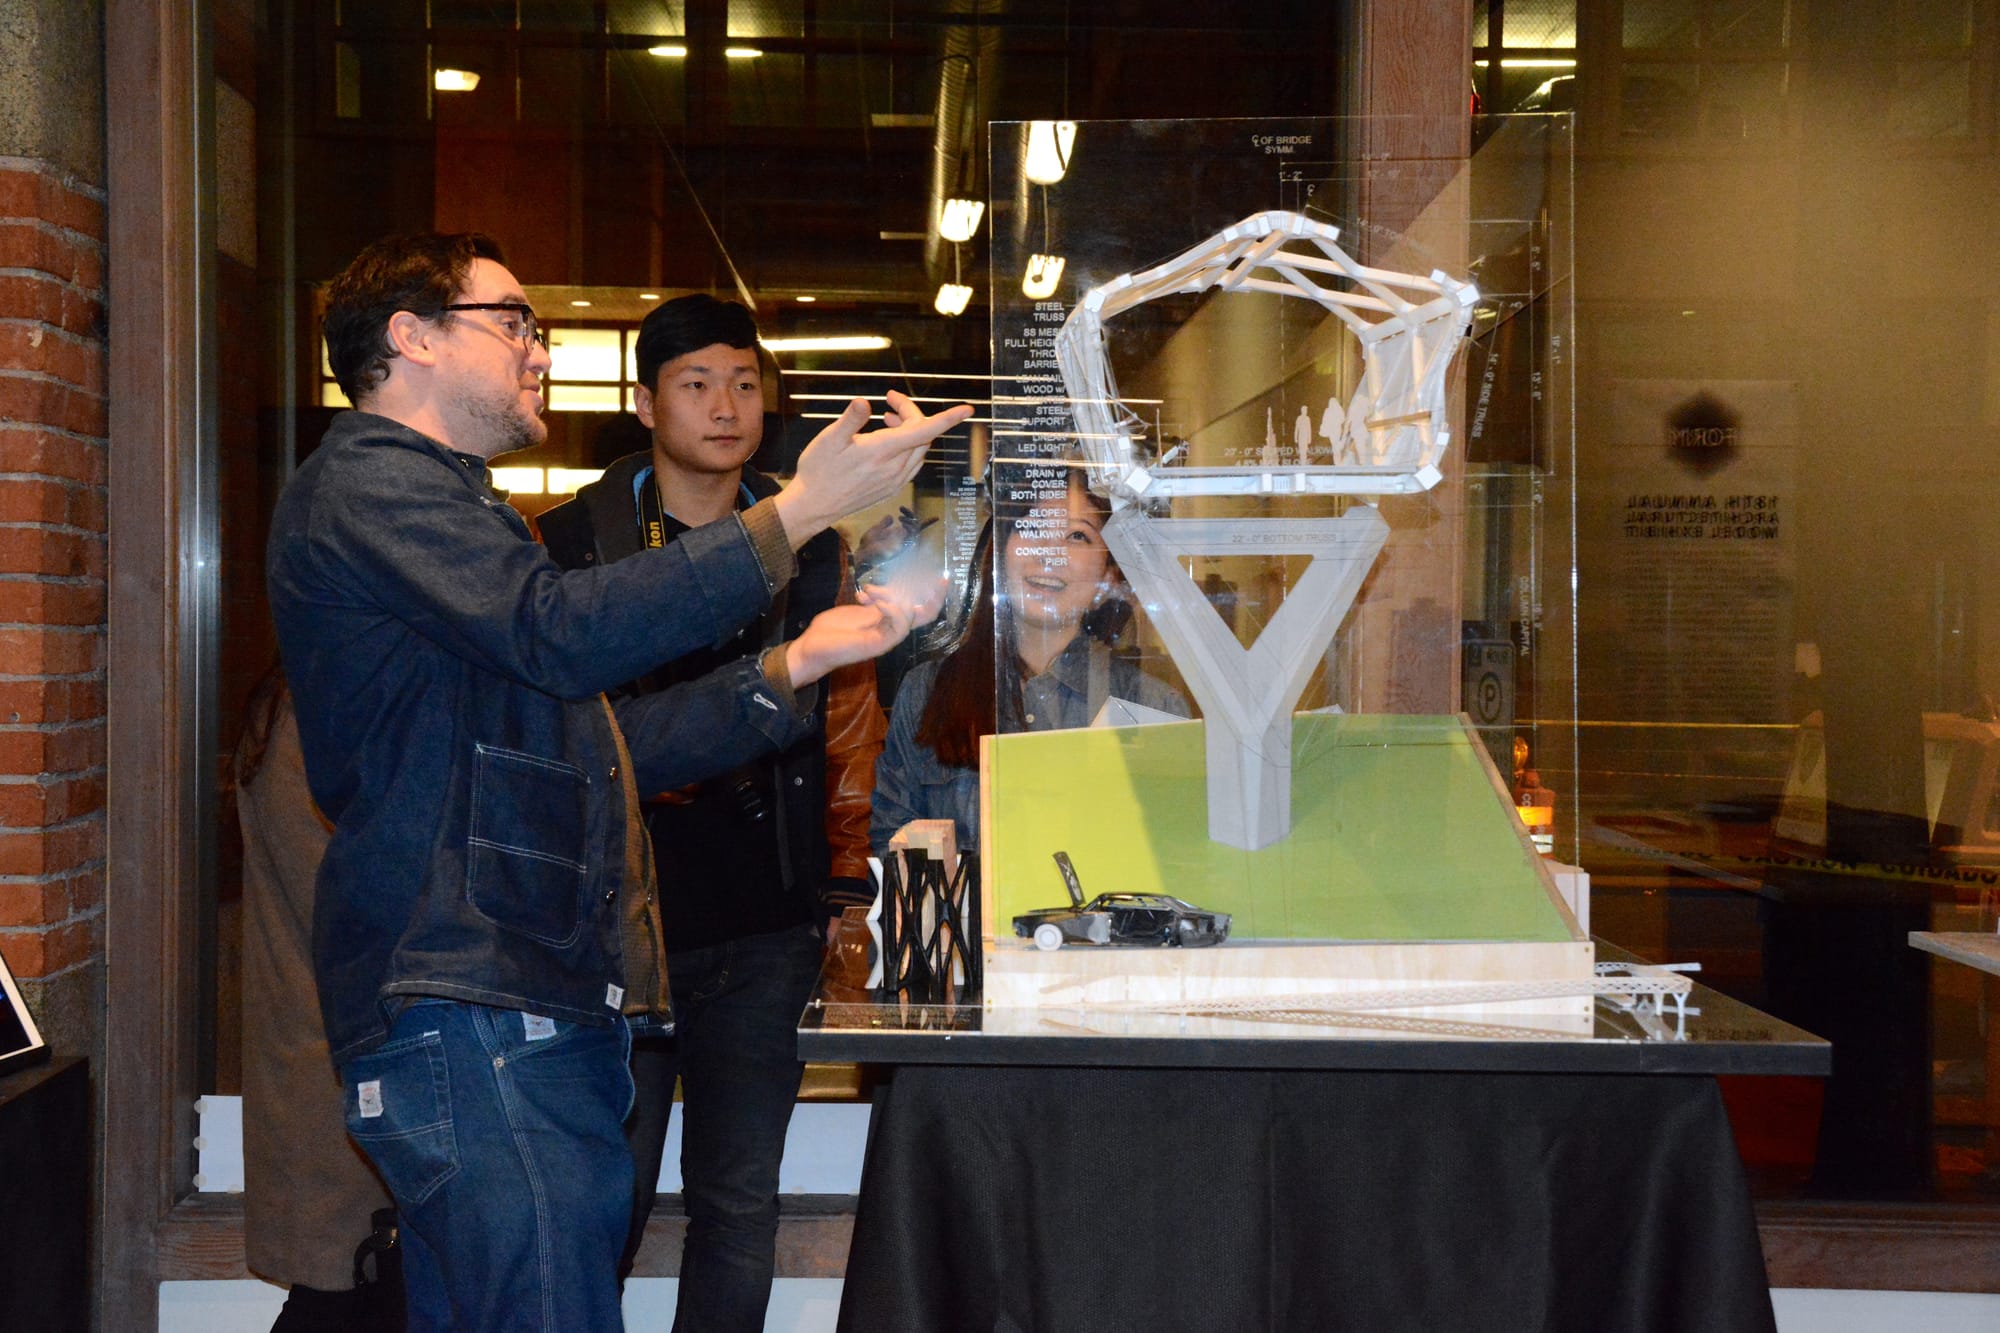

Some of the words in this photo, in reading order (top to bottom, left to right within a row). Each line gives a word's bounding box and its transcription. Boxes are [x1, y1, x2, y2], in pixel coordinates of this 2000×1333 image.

[1260, 135, 1275, 145] OF
[1276, 135, 1313, 145] BRIDGE
[1034, 302, 1065, 311] STEEL
[1033, 313, 1065, 322] TRUSS
[1023, 328, 1037, 337] SS
[1004, 338, 1028, 348] FULL
[1029, 338, 1057, 348] HEIG
[1029, 349, 1057, 359] THRO
[1023, 359, 1060, 369] BARRIE
[1023, 384, 1054, 394] WOOD
[1036, 406, 1065, 415] STEEL
[1021, 417, 1066, 426] SUPPORT
[1471, 406, 1489, 438] TRUSS
[1017, 443, 1037, 453] LED
[1038, 443, 1066, 452] LIGHT
[1025, 469, 1055, 479] DRAIN
[1056, 469, 1067, 479] w/
[1010, 490, 1037, 500] BOTH
[1038, 490, 1067, 500] SIDES
[1029, 508, 1068, 518] SLOPED
[1015, 519, 1068, 529] CONCRETE
[649, 521, 663, 548] kon
[1019, 529, 1066, 539] WALKWAY
[1015, 546, 1068, 556] CONCRETE
[1045, 557, 1068, 566] PIER
[1520, 617, 1531, 657] CAPITAL
